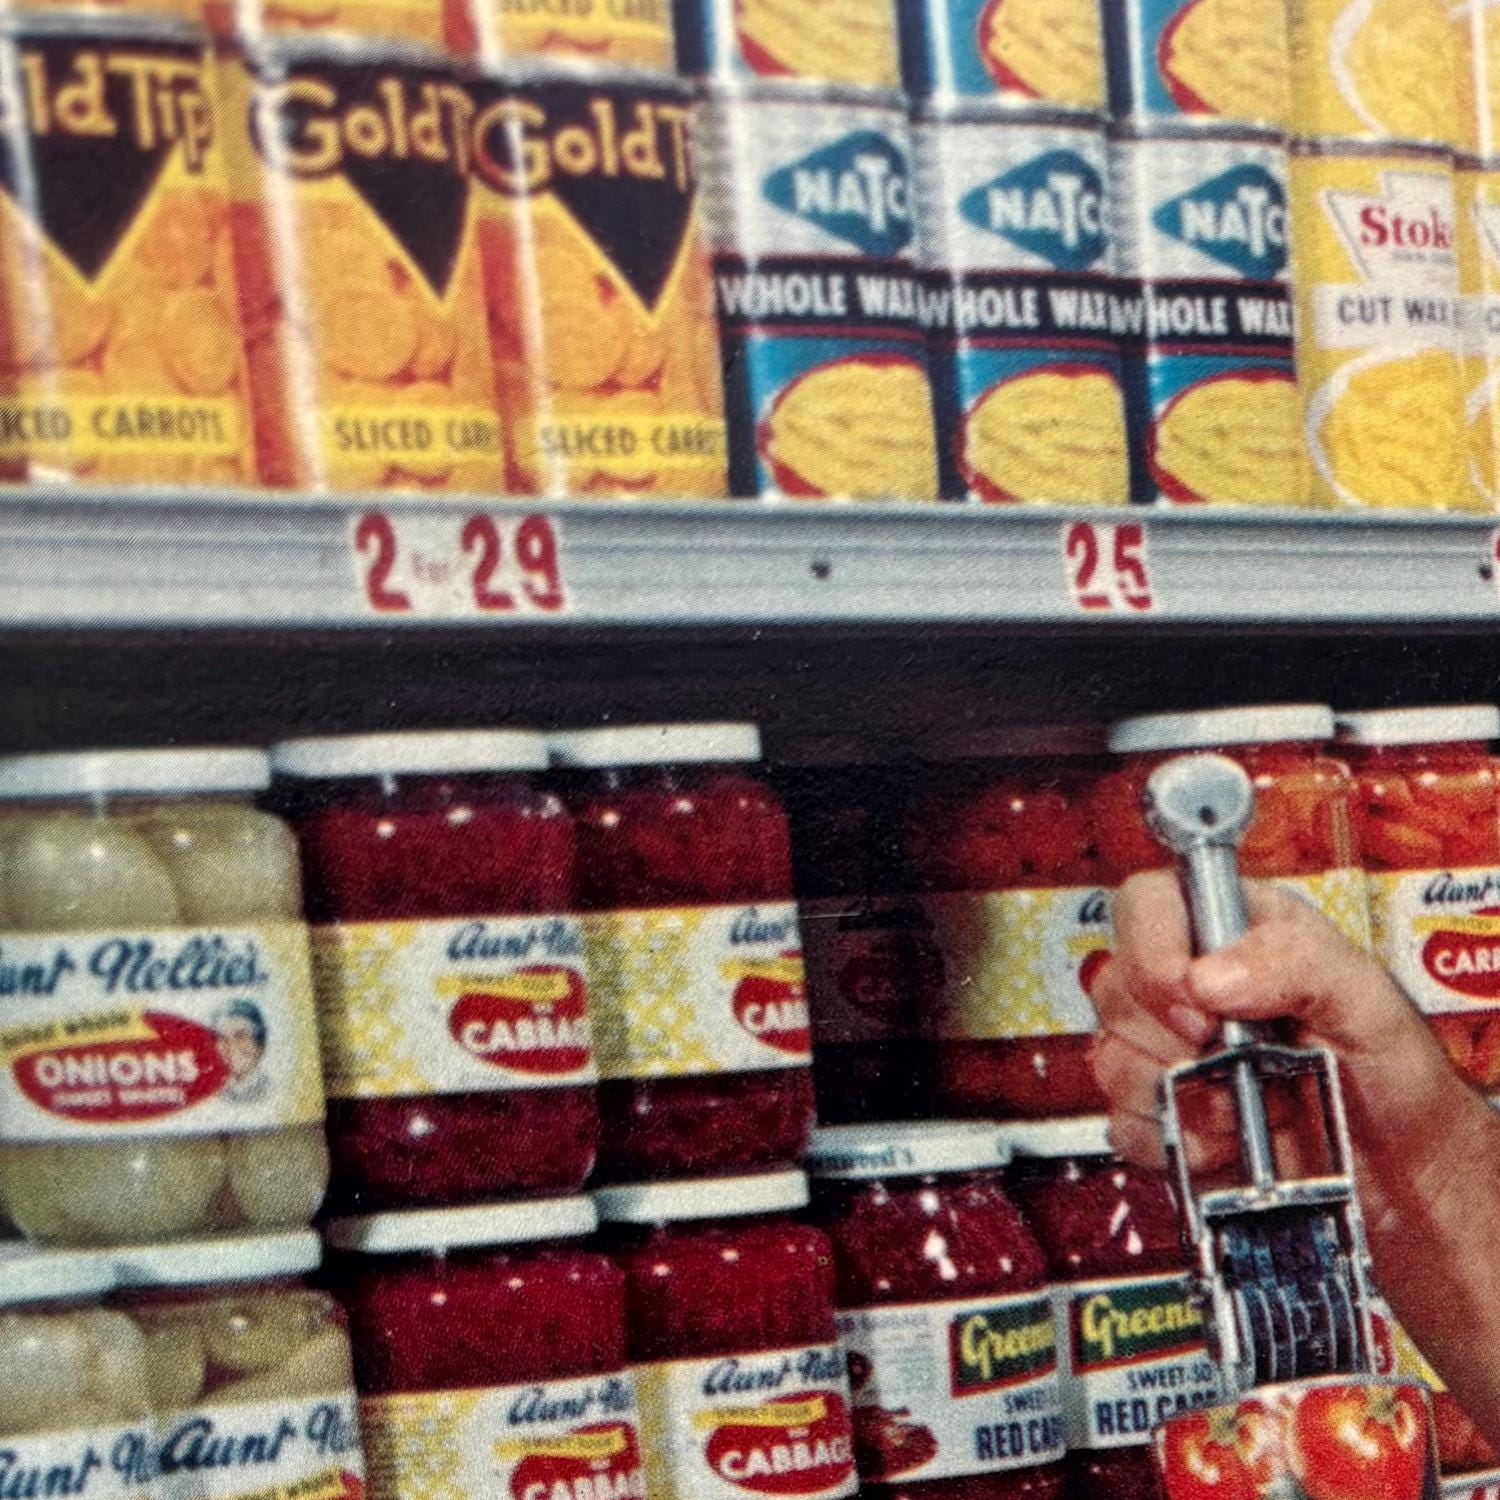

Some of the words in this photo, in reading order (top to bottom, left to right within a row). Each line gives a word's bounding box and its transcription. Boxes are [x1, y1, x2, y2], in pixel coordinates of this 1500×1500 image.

[721, 272, 846, 319] WHOLE
[916, 287, 1040, 329] WHOLE
[1104, 294, 1228, 337] WHOLE
[1338, 299, 1397, 327] CUT
[333, 419, 433, 453] SLICED
[539, 424, 637, 459] SLICED
[356, 514, 410, 613] 2
[461, 514, 564, 613] 29
[1066, 521, 1153, 612] 25
[1424, 871, 1490, 904] Aunt
[448, 922, 538, 962] Aunt
[35, 1050, 199, 1088] ONIONS
[701, 1356, 791, 1397] Aunt
[507, 1384, 584, 1428] Aunt
[1095, 1399, 1152, 1435] RED
[160, 1417, 297, 1476] Aunt
[975, 1423, 1024, 1461] RED
